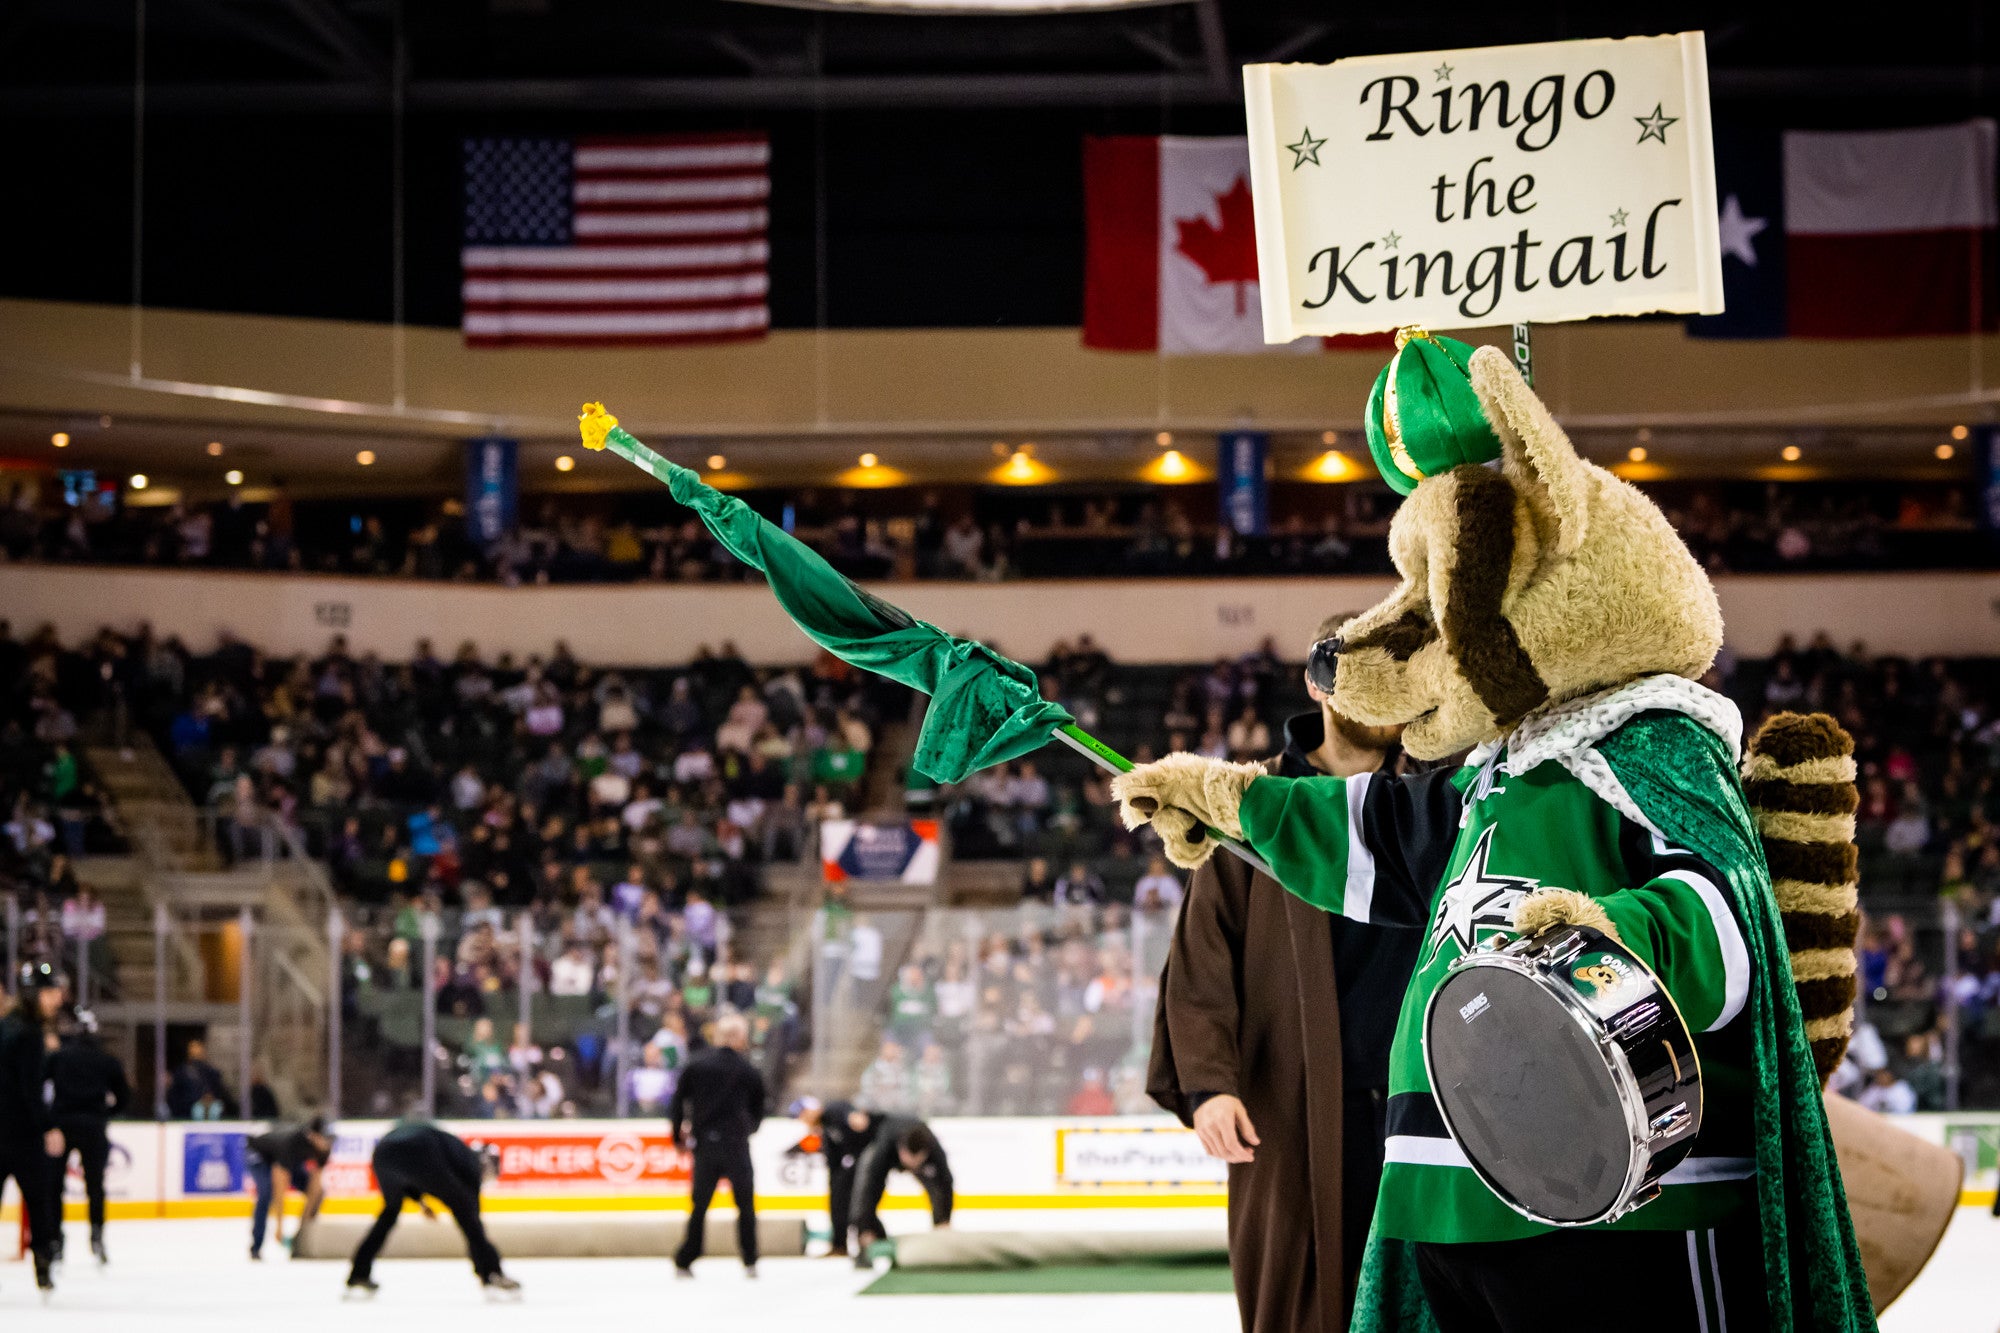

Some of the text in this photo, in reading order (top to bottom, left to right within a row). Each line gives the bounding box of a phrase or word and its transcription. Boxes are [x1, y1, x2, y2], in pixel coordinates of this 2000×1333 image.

[1360, 66, 1616, 152] Ringo
[1431, 157, 1537, 223] the
[1302, 199, 1682, 318] Kingtail
